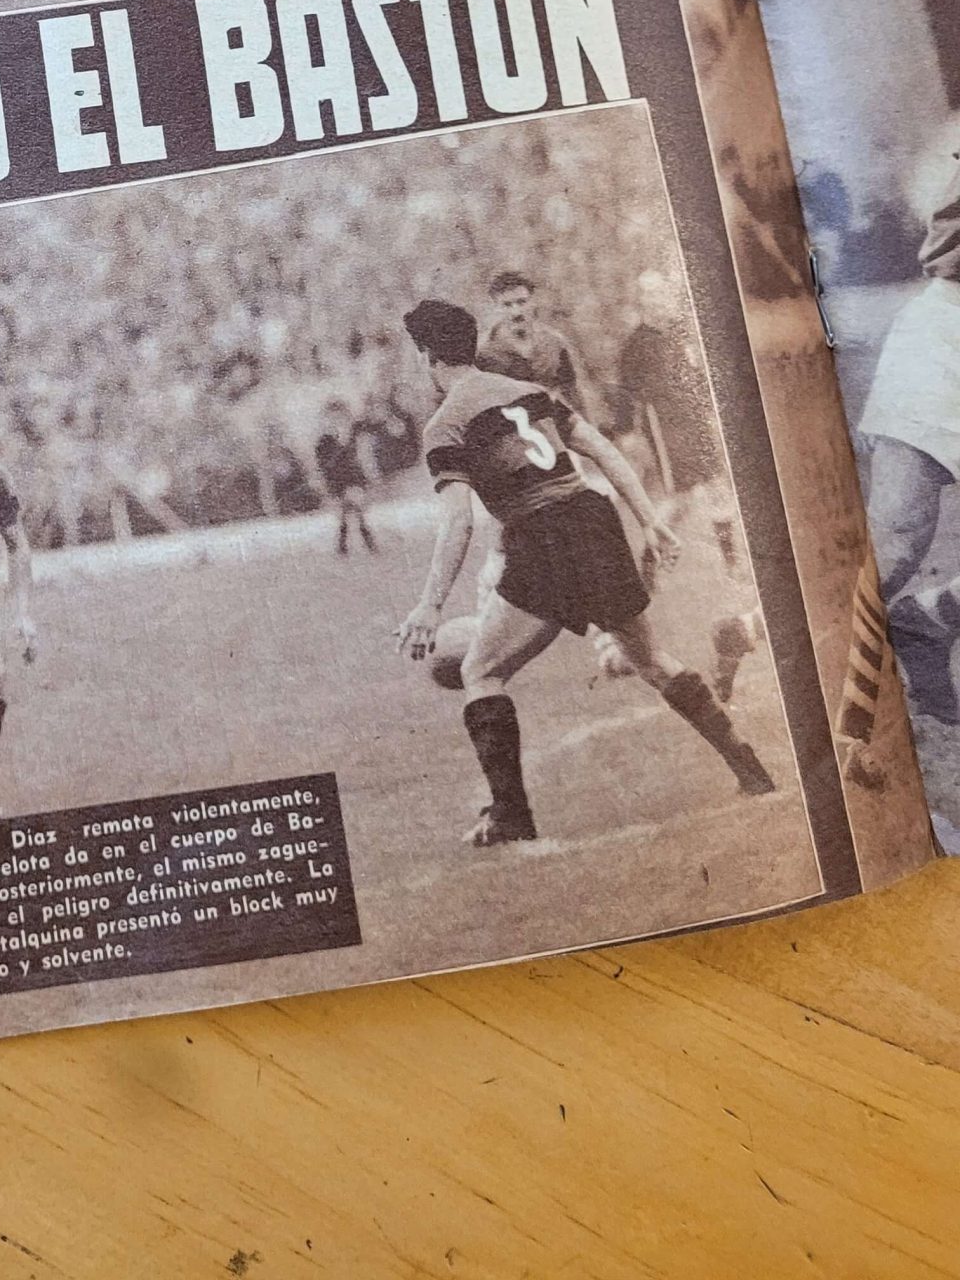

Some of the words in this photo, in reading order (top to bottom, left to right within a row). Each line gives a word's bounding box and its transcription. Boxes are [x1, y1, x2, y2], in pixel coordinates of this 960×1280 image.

[39, 8, 167, 173] EL
[64, 846, 88, 866] da
[102, 845, 125, 859] en
[139, 834, 156, 853] el
[171, 827, 238, 849] cuerpo
[251, 818, 274, 837] de
[288, 812, 325, 831] Ba-
[82, 815, 154, 838] remata
[172, 789, 321, 823] violentamente,
[153, 857, 170, 877] el
[182, 850, 247, 872] mismo
[258, 838, 329, 861] zague-
[0, 925, 84, 952] talquina
[97, 905, 182, 939] presentó
[194, 906, 218, 922] un
[230, 891, 284, 916] block
[296, 887, 338, 906] muy
[7, 905, 25, 925] el
[42, 895, 110, 922] peligro
[126, 867, 293, 905] definitivamente.
[308, 860, 333, 878] La
[19, 960, 30, 976] y
[42, 942, 132, 970] solvente.
